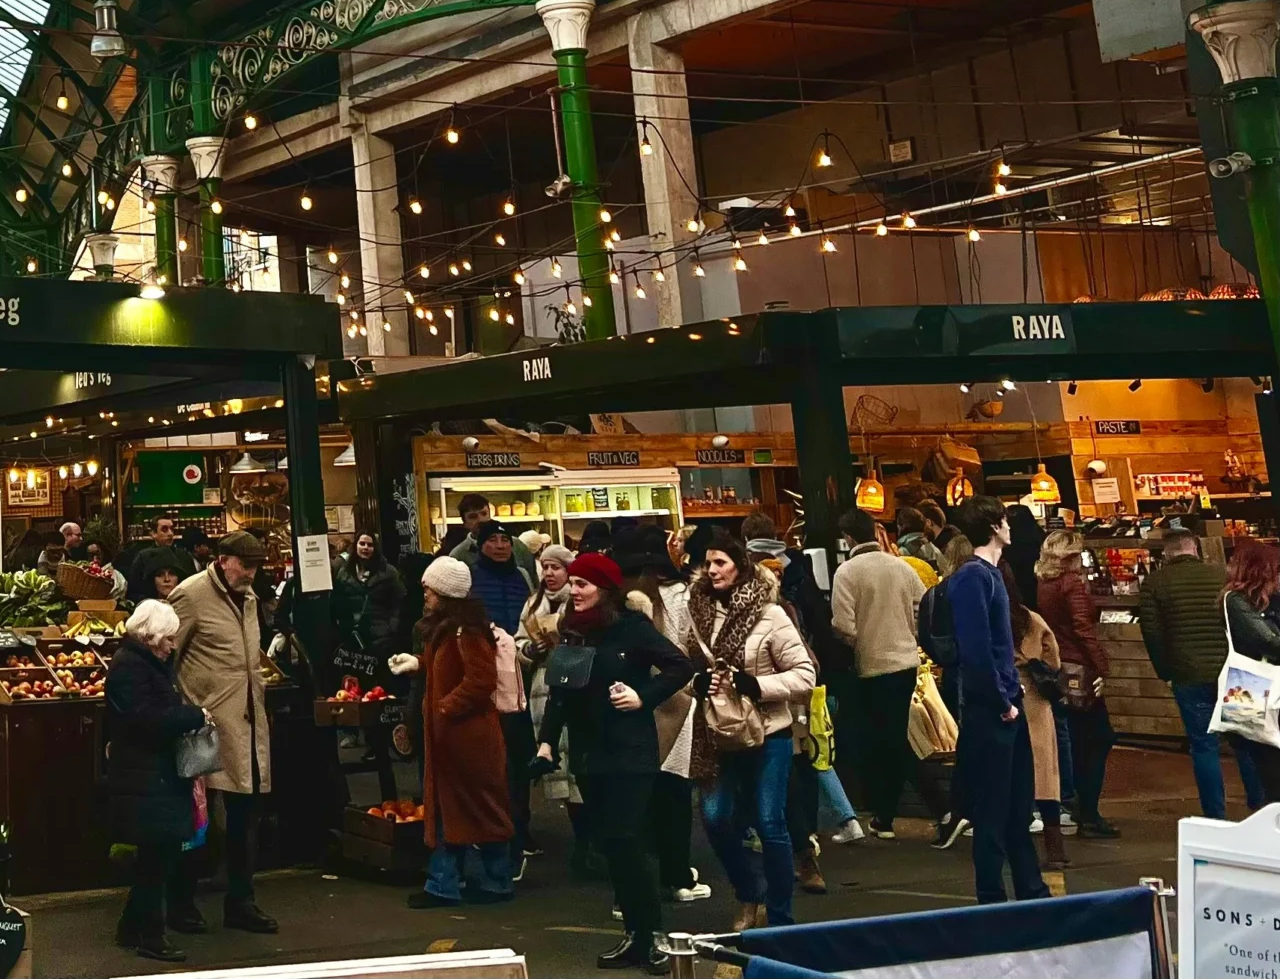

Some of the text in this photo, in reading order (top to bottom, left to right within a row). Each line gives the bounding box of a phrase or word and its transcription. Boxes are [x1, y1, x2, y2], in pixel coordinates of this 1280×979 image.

[1011, 315, 1066, 339] RAYA
[522, 356, 552, 381] RAYA
[1098, 421, 1129, 434] PASTE
[467, 454, 493, 467] HERBS
[588, 452, 612, 465] FRUIT
[619, 452, 638, 465] VEG
[697, 450, 737, 463] NOODLES
[1203, 907, 1253, 927] SONS
[1257, 949, 1270, 961] of
